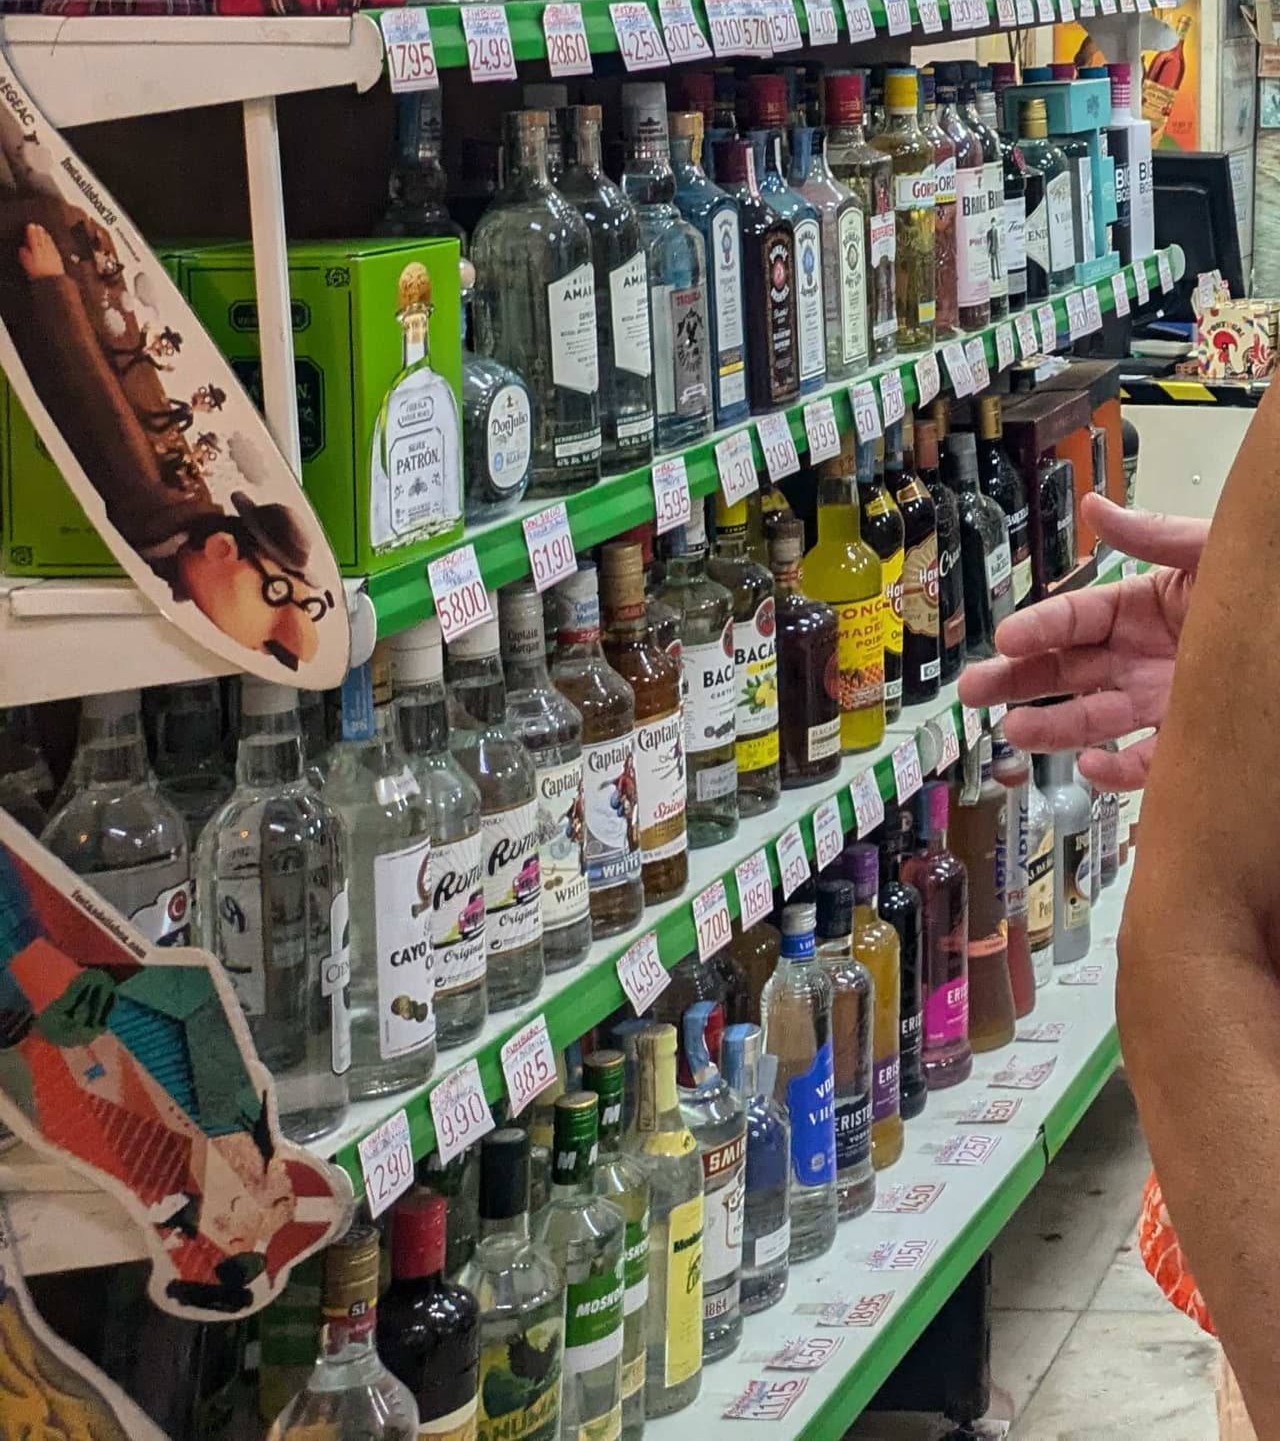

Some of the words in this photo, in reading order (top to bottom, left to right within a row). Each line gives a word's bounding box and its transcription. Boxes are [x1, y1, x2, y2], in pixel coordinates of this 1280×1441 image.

[468, 37, 513, 71] 24,99
[547, 32, 587, 67] 28,60
[619, 31, 665, 65] 42,50
[664, 21, 706, 55] 30,75
[387, 43, 435, 80] 17,95
[1, 83, 36, 127] EGEAC
[767, 440, 797, 474] 31,90
[655, 490, 690, 526] 45,95
[531, 537, 574, 582] 61,90
[438, 582, 488, 630] 58,00
[637, 722, 681, 752] Captain
[588, 744, 634, 774] Captain
[540, 771, 581, 799] Captain
[600, 851, 641, 879] WHITE
[555, 880, 589, 905] WHITE
[742, 877, 772, 912] 18,50
[697, 908, 730, 951] 17,00
[390, 940, 427, 968] CAYO
[623, 949, 661, 994] 14,95
[441, 1091, 484, 1149] 9,90
[365, 1142, 411, 1203] 12,90
[351, 1301, 366, 1317] 51
[704, 1299, 728, 1318] 1864
